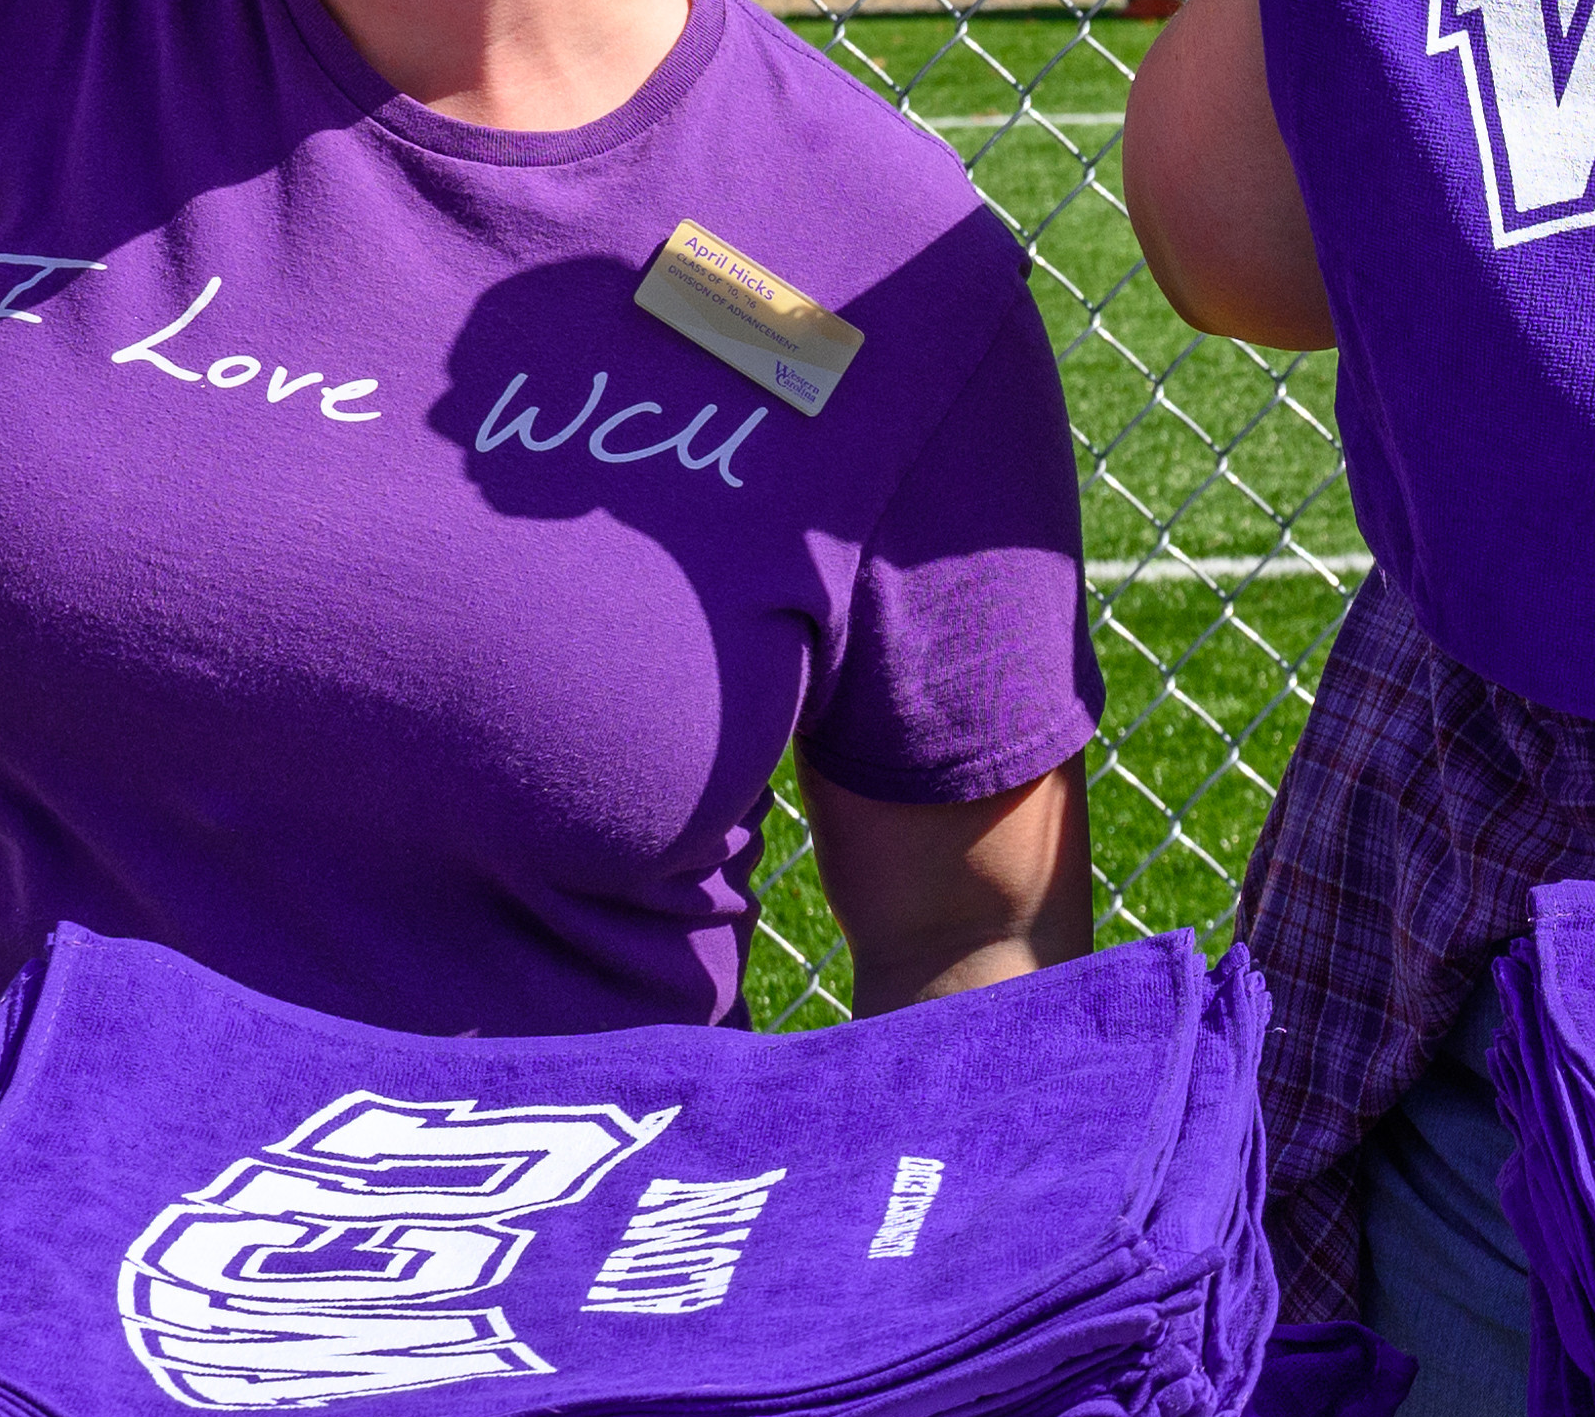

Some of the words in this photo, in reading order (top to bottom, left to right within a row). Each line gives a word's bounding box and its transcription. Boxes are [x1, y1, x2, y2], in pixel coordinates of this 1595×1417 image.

[676, 252, 707, 276] CLASS
[707, 271, 722, 286] OF
[684, 236, 728, 270] April
[728, 262, 776, 301] Hicks
[667, 264, 710, 297] DIVISION
[711, 293, 727, 306] OF
[726, 302, 801, 354] ADVANCEMENT
[110, 275, 383, 423] Love
[776, 360, 820, 394] Western
[776, 373, 817, 403] Carolina
[117, 1089, 683, 1410] WCU
[580, 1168, 788, 1314] ALUMNI
